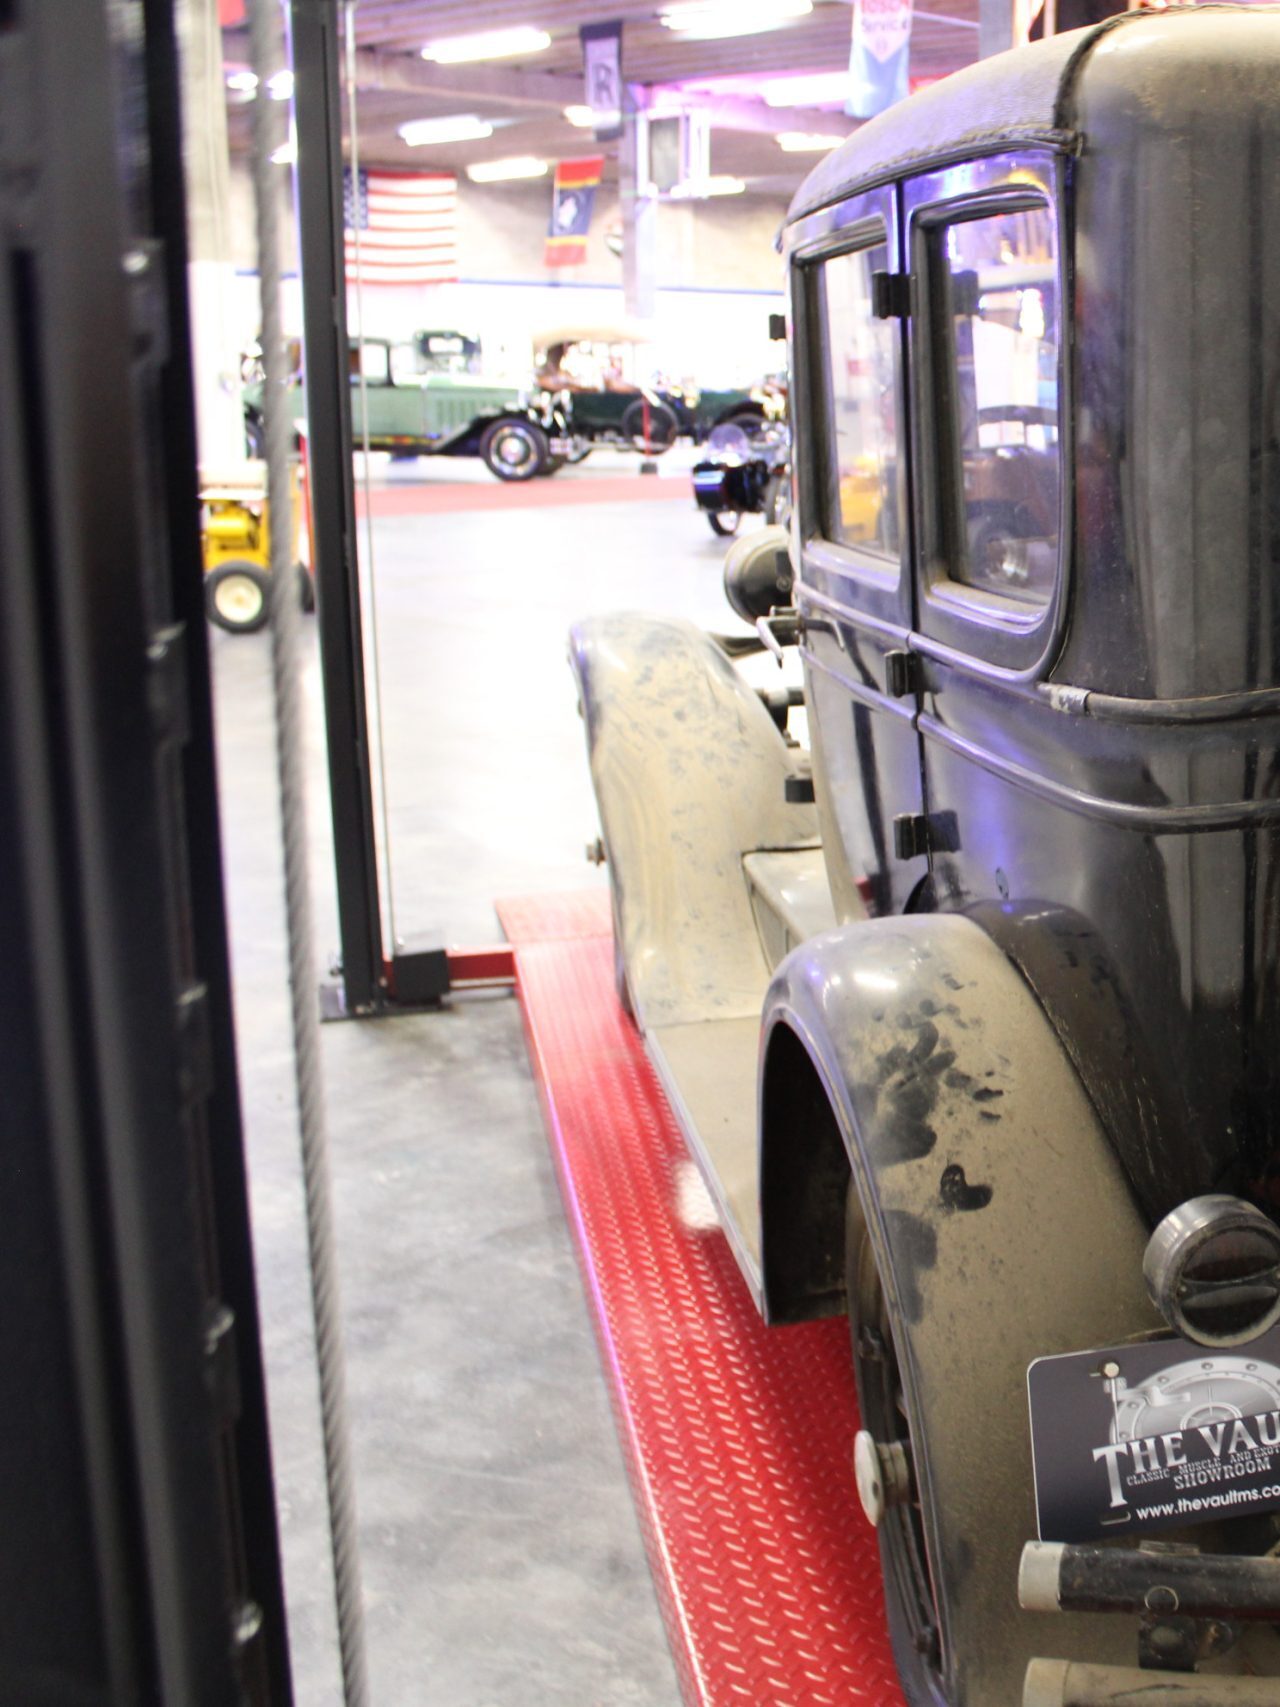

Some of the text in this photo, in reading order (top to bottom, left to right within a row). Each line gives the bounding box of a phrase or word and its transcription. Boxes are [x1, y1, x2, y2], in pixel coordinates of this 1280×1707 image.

[1092, 1432, 1187, 1508] THE
[1126, 1467, 1170, 1486] CLASSIC
[1178, 1456, 1221, 1475] MUSCLE
[1229, 1450, 1252, 1464] AND
[1173, 1456, 1272, 1490] SHOWROOM
